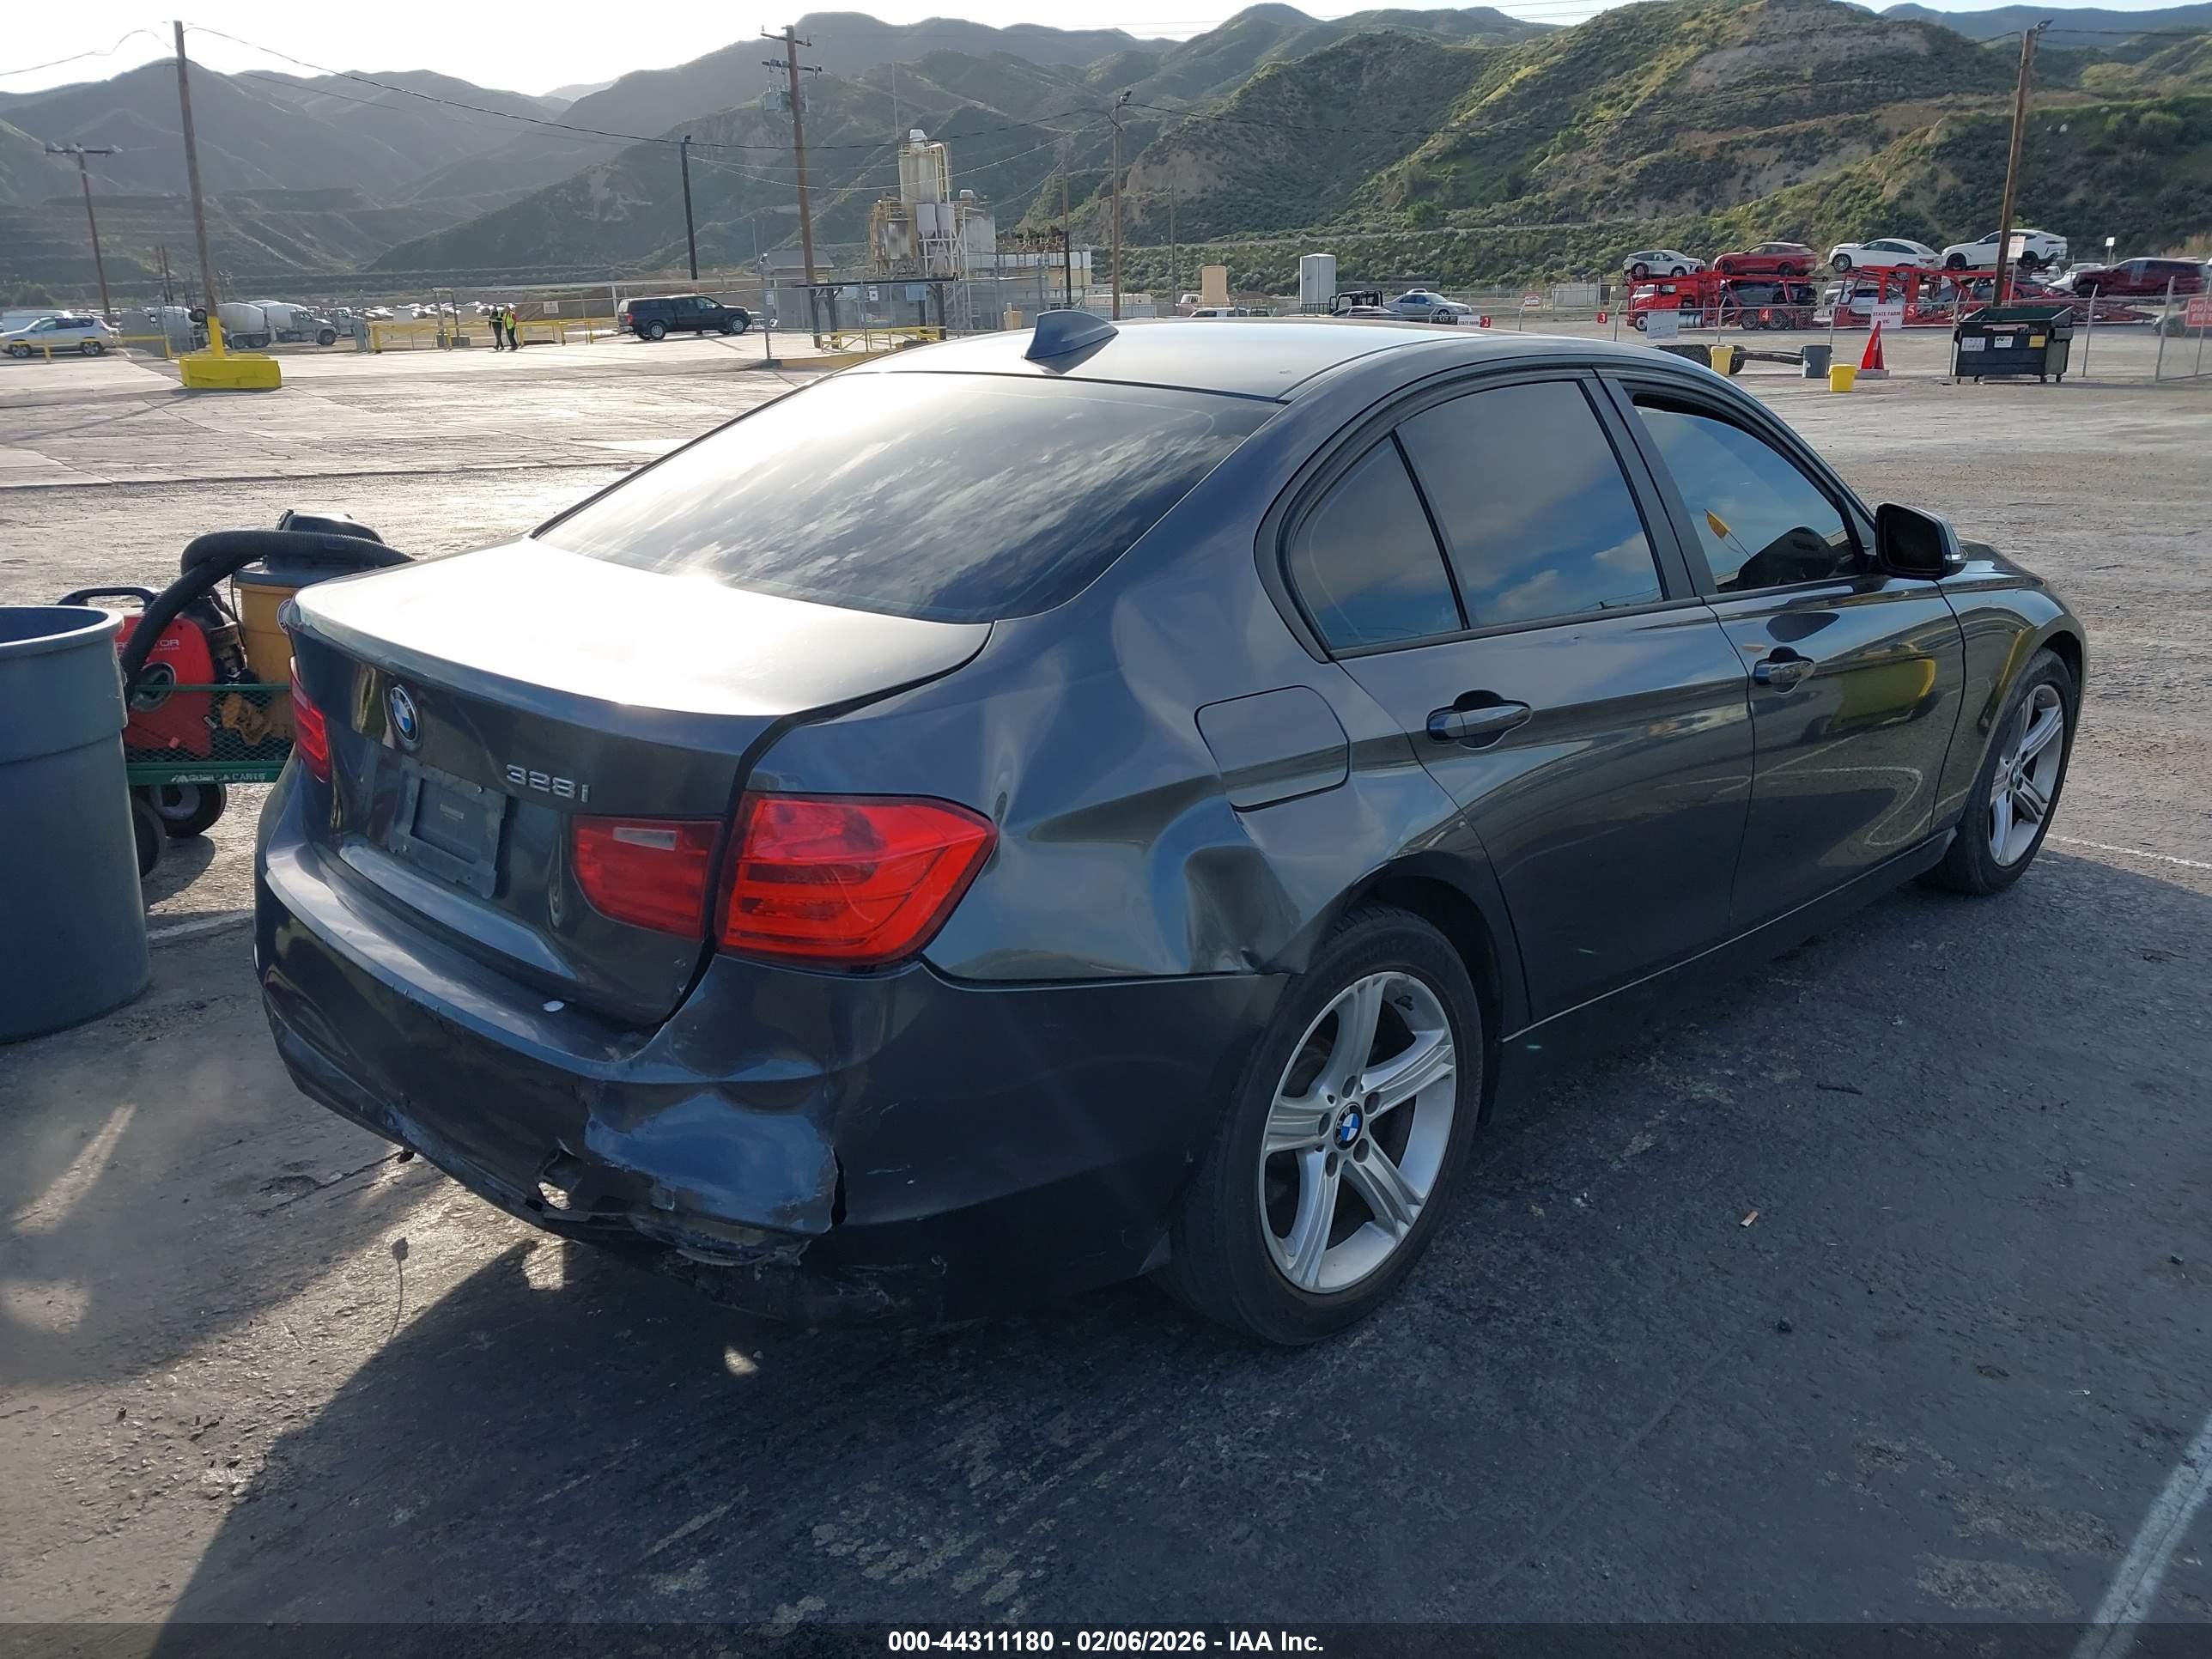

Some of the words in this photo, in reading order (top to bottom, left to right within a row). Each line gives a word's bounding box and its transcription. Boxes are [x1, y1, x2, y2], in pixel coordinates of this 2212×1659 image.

[1762, 308, 1769, 321] 4
[1907, 305, 1915, 316] 5
[1483, 317, 1490, 327] 2
[1599, 313, 1606, 323] 3
